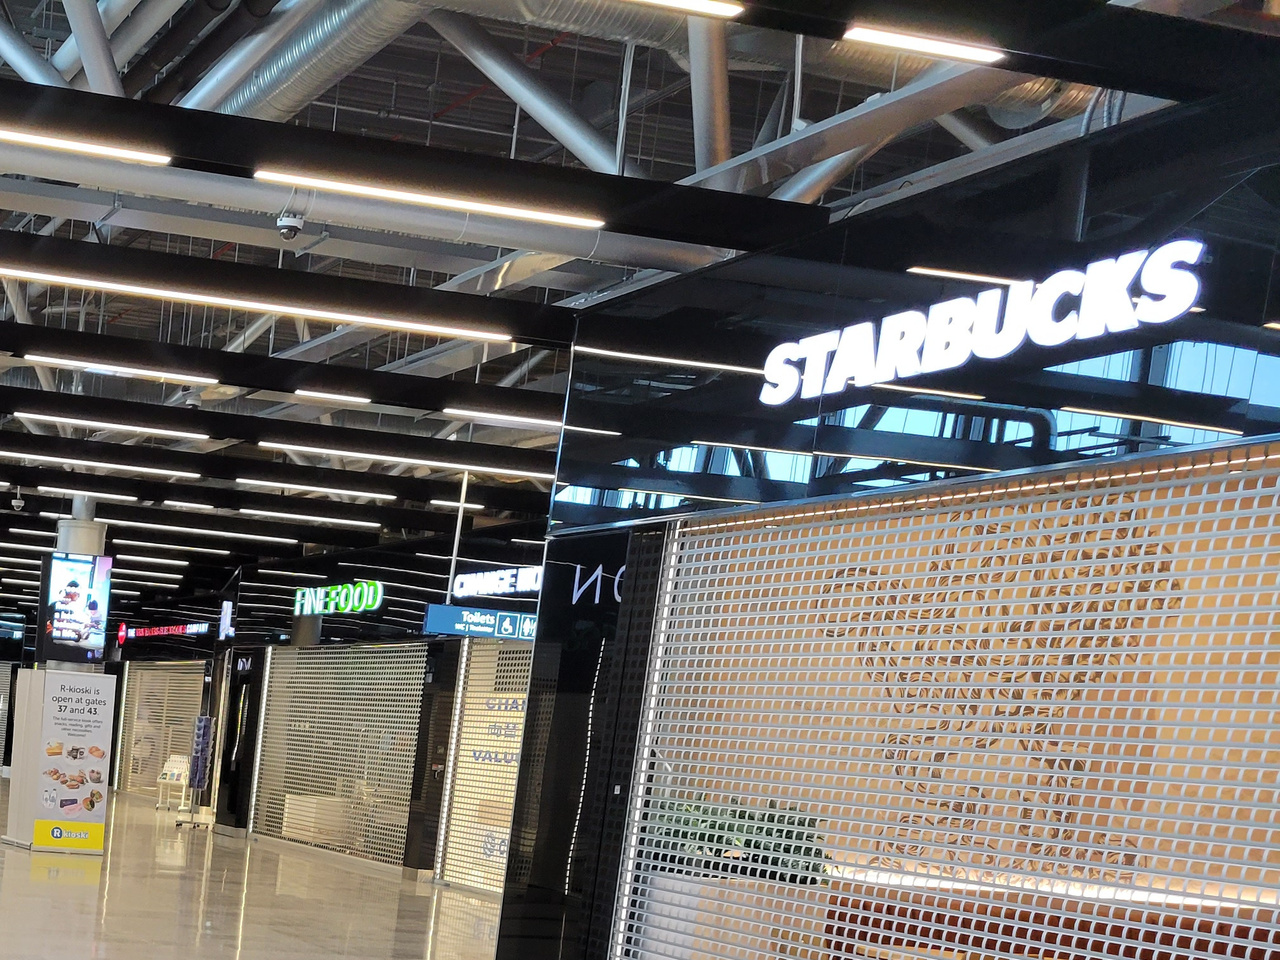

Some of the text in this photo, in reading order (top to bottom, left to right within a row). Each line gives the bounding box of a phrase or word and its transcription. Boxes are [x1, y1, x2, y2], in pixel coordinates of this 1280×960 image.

[759, 239, 1206, 406] STARBUCKS
[461, 611, 495, 625] Toilets
[60, 684, 100, 695] R-kioski is
[51, 696, 73, 704] open
[85, 698, 107, 706] gates
[57, 705, 68, 713] 37
